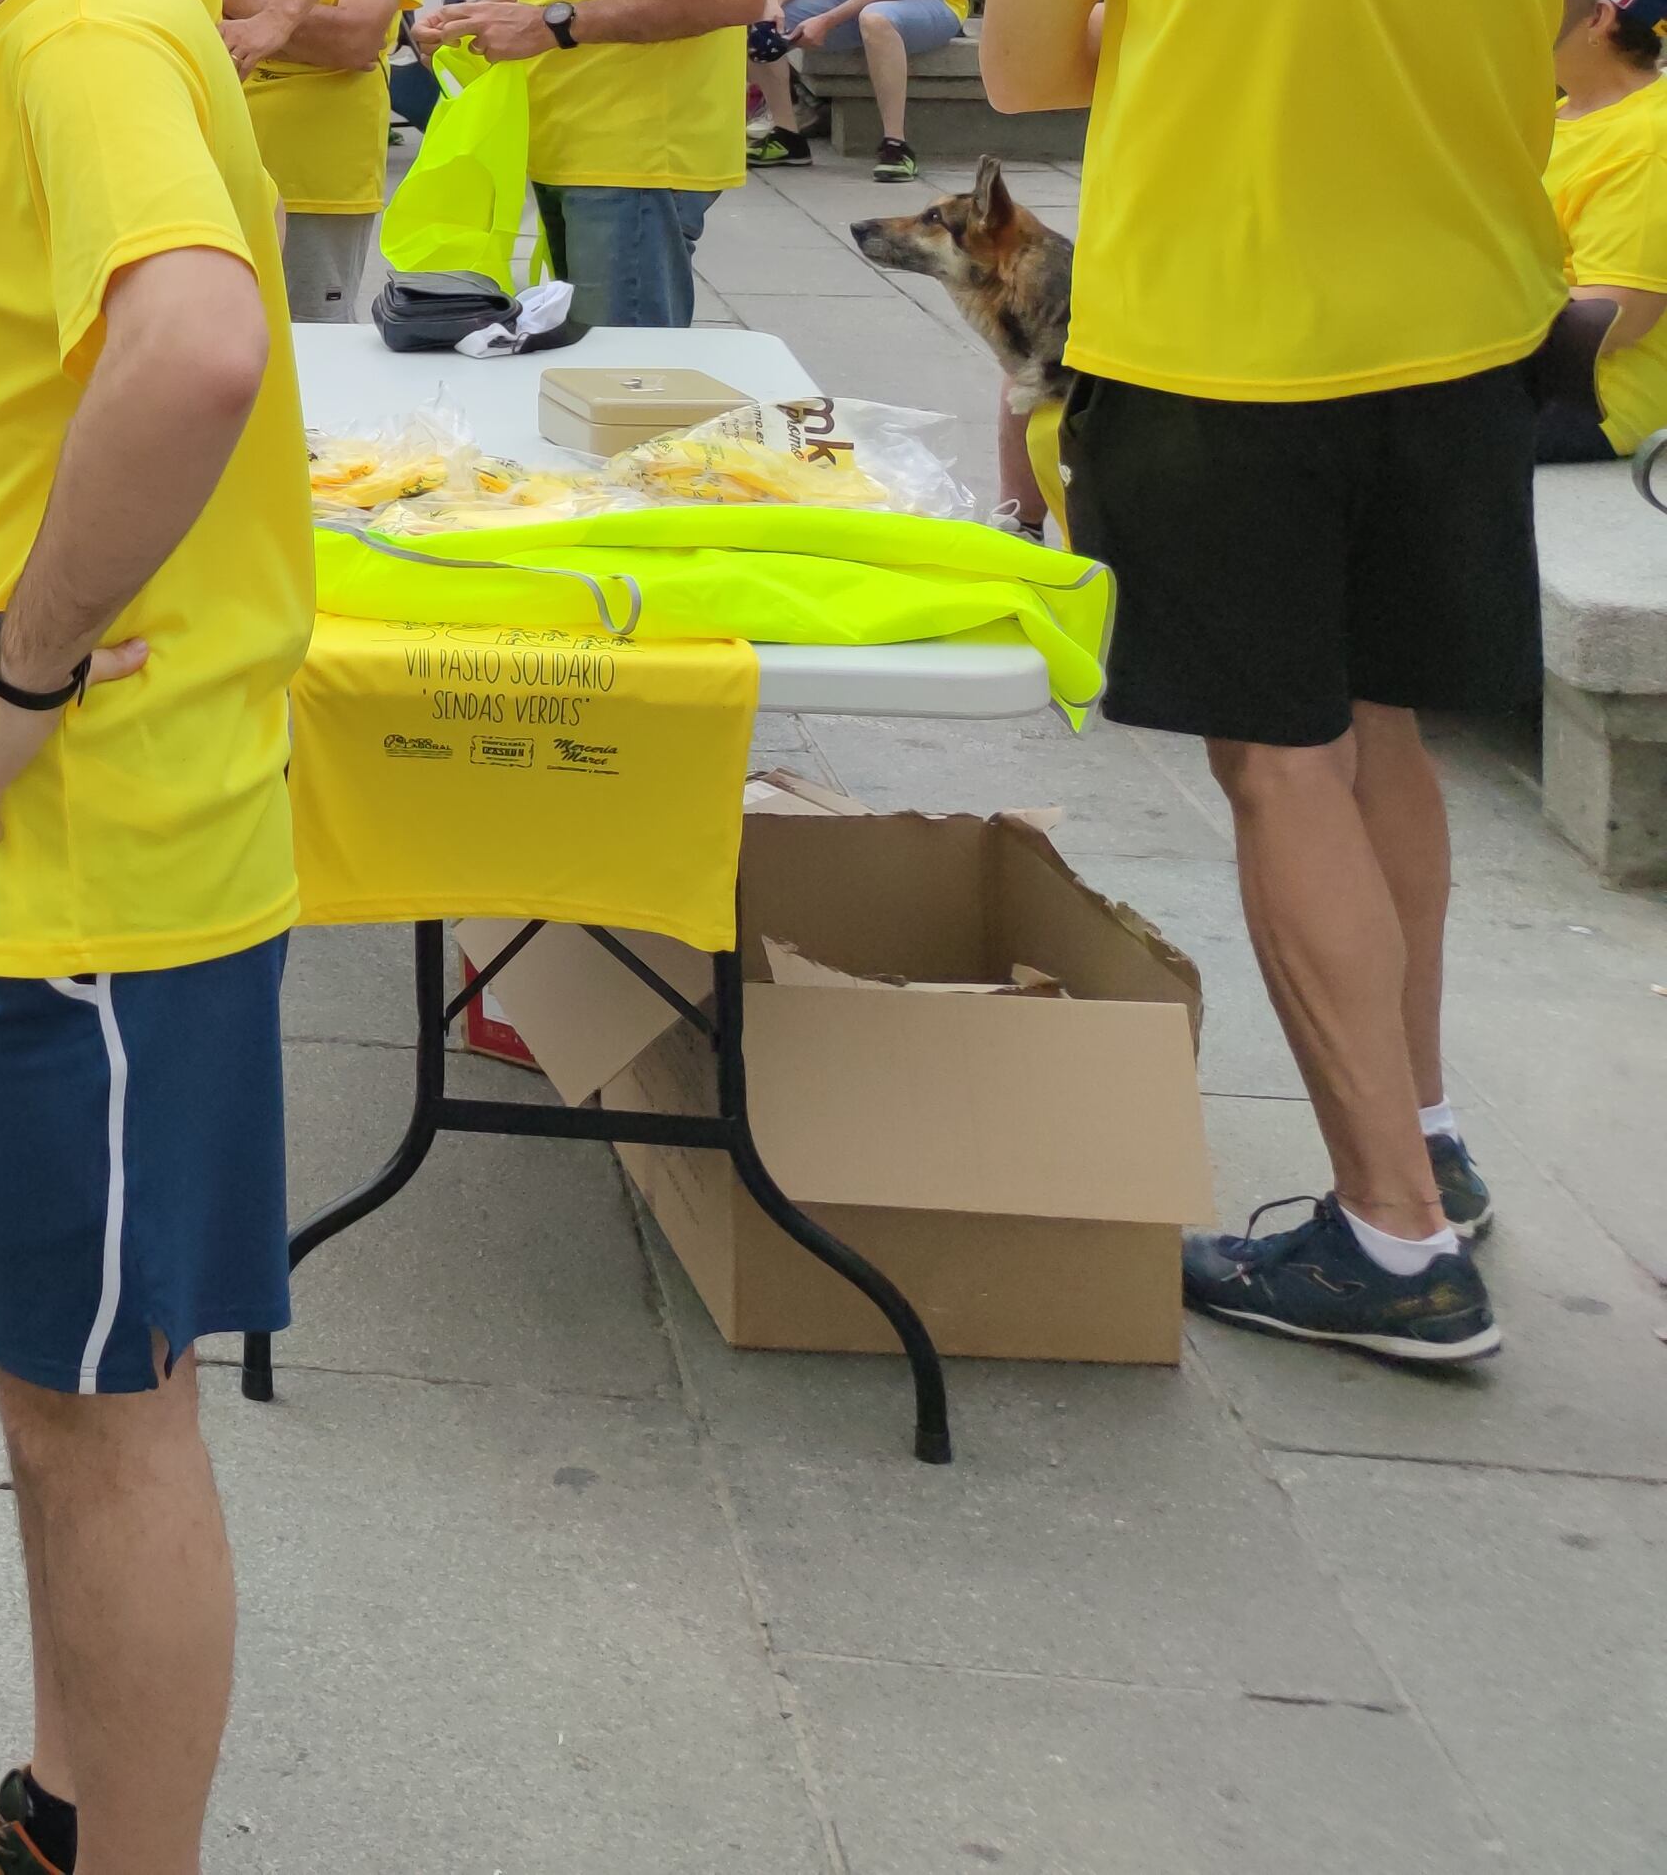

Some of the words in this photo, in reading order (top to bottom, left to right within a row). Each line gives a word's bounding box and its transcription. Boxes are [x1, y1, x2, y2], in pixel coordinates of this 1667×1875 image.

[405, 647, 430, 678] VIII
[440, 649, 500, 684] PASEO
[510, 651, 615, 692] SOLIDARIO
